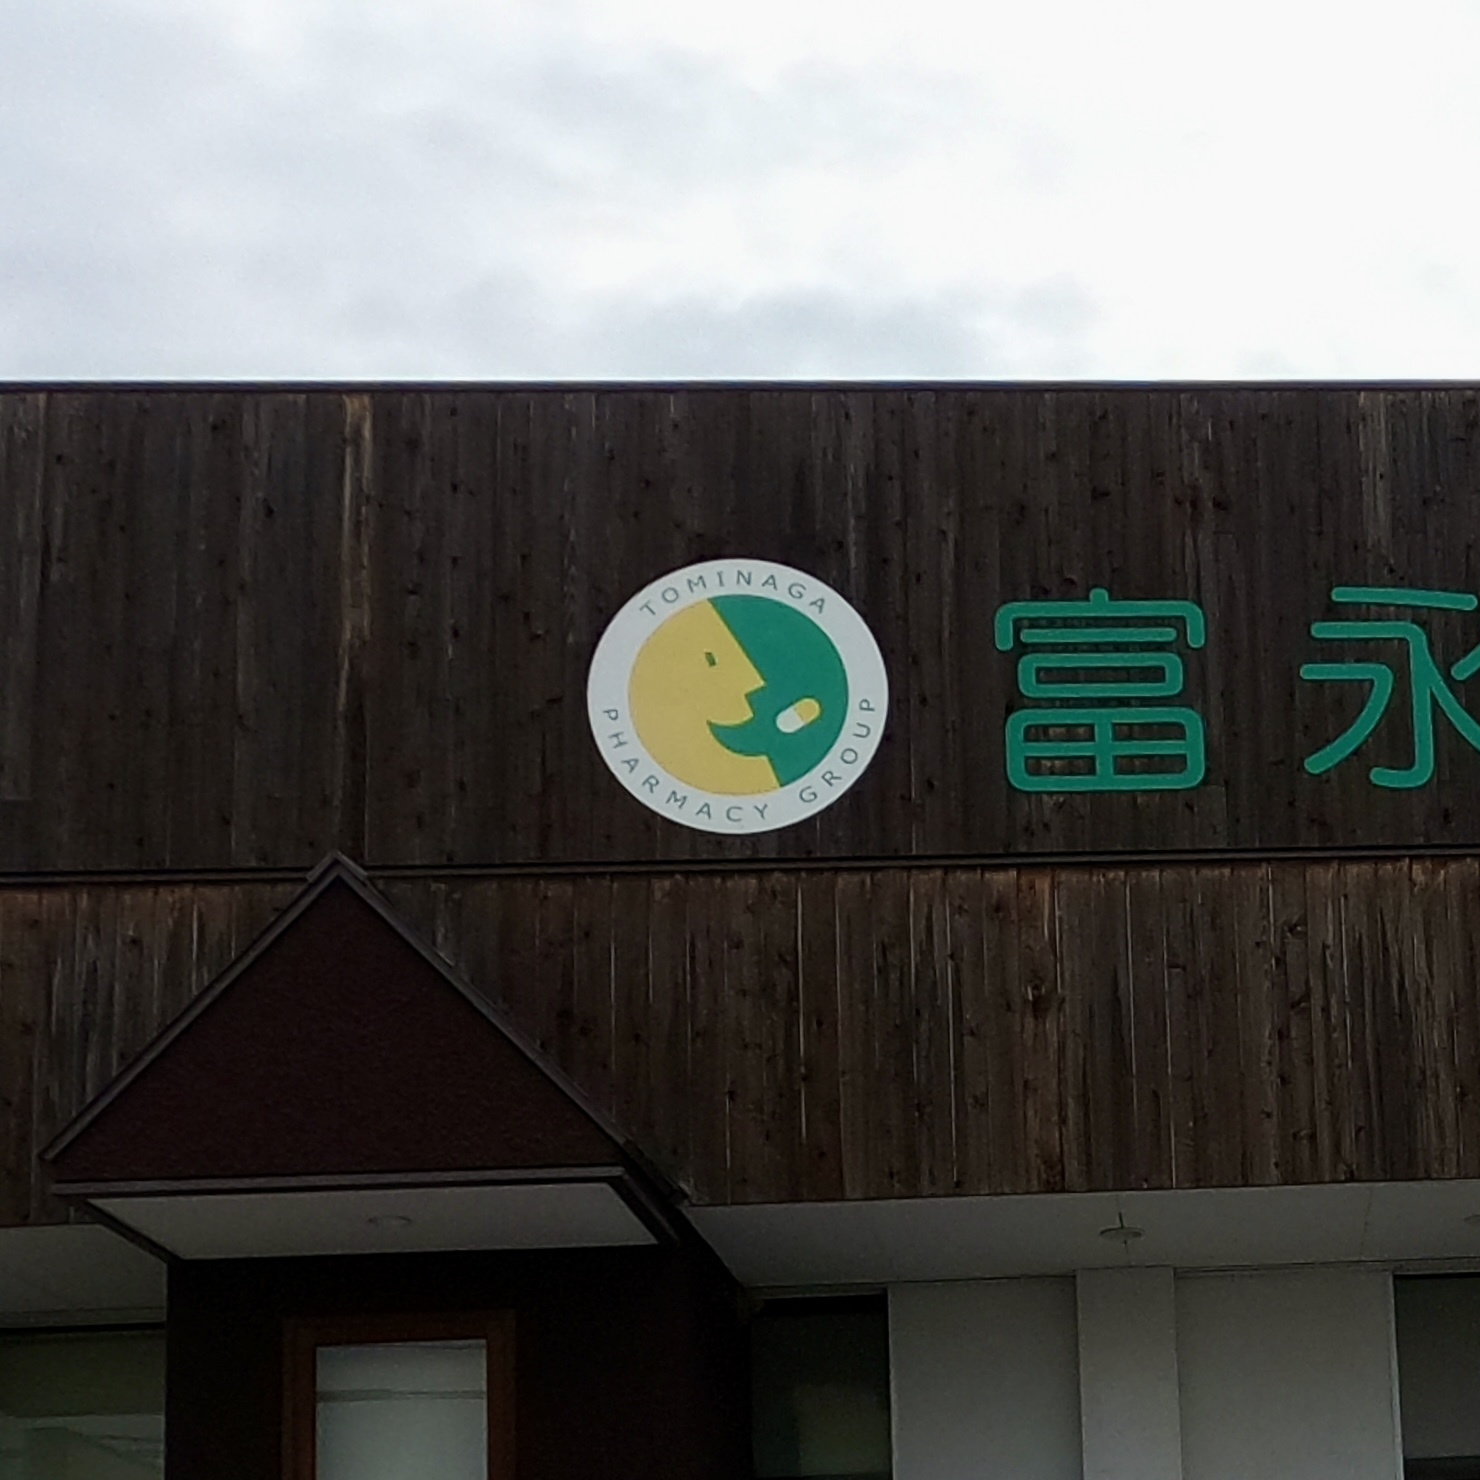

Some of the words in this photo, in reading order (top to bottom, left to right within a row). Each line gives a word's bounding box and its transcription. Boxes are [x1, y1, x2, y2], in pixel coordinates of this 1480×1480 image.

[639, 569, 827, 617] TOMINAGA
[603, 708, 769, 823] PHARMACY
[798, 697, 876, 805] GROUP
